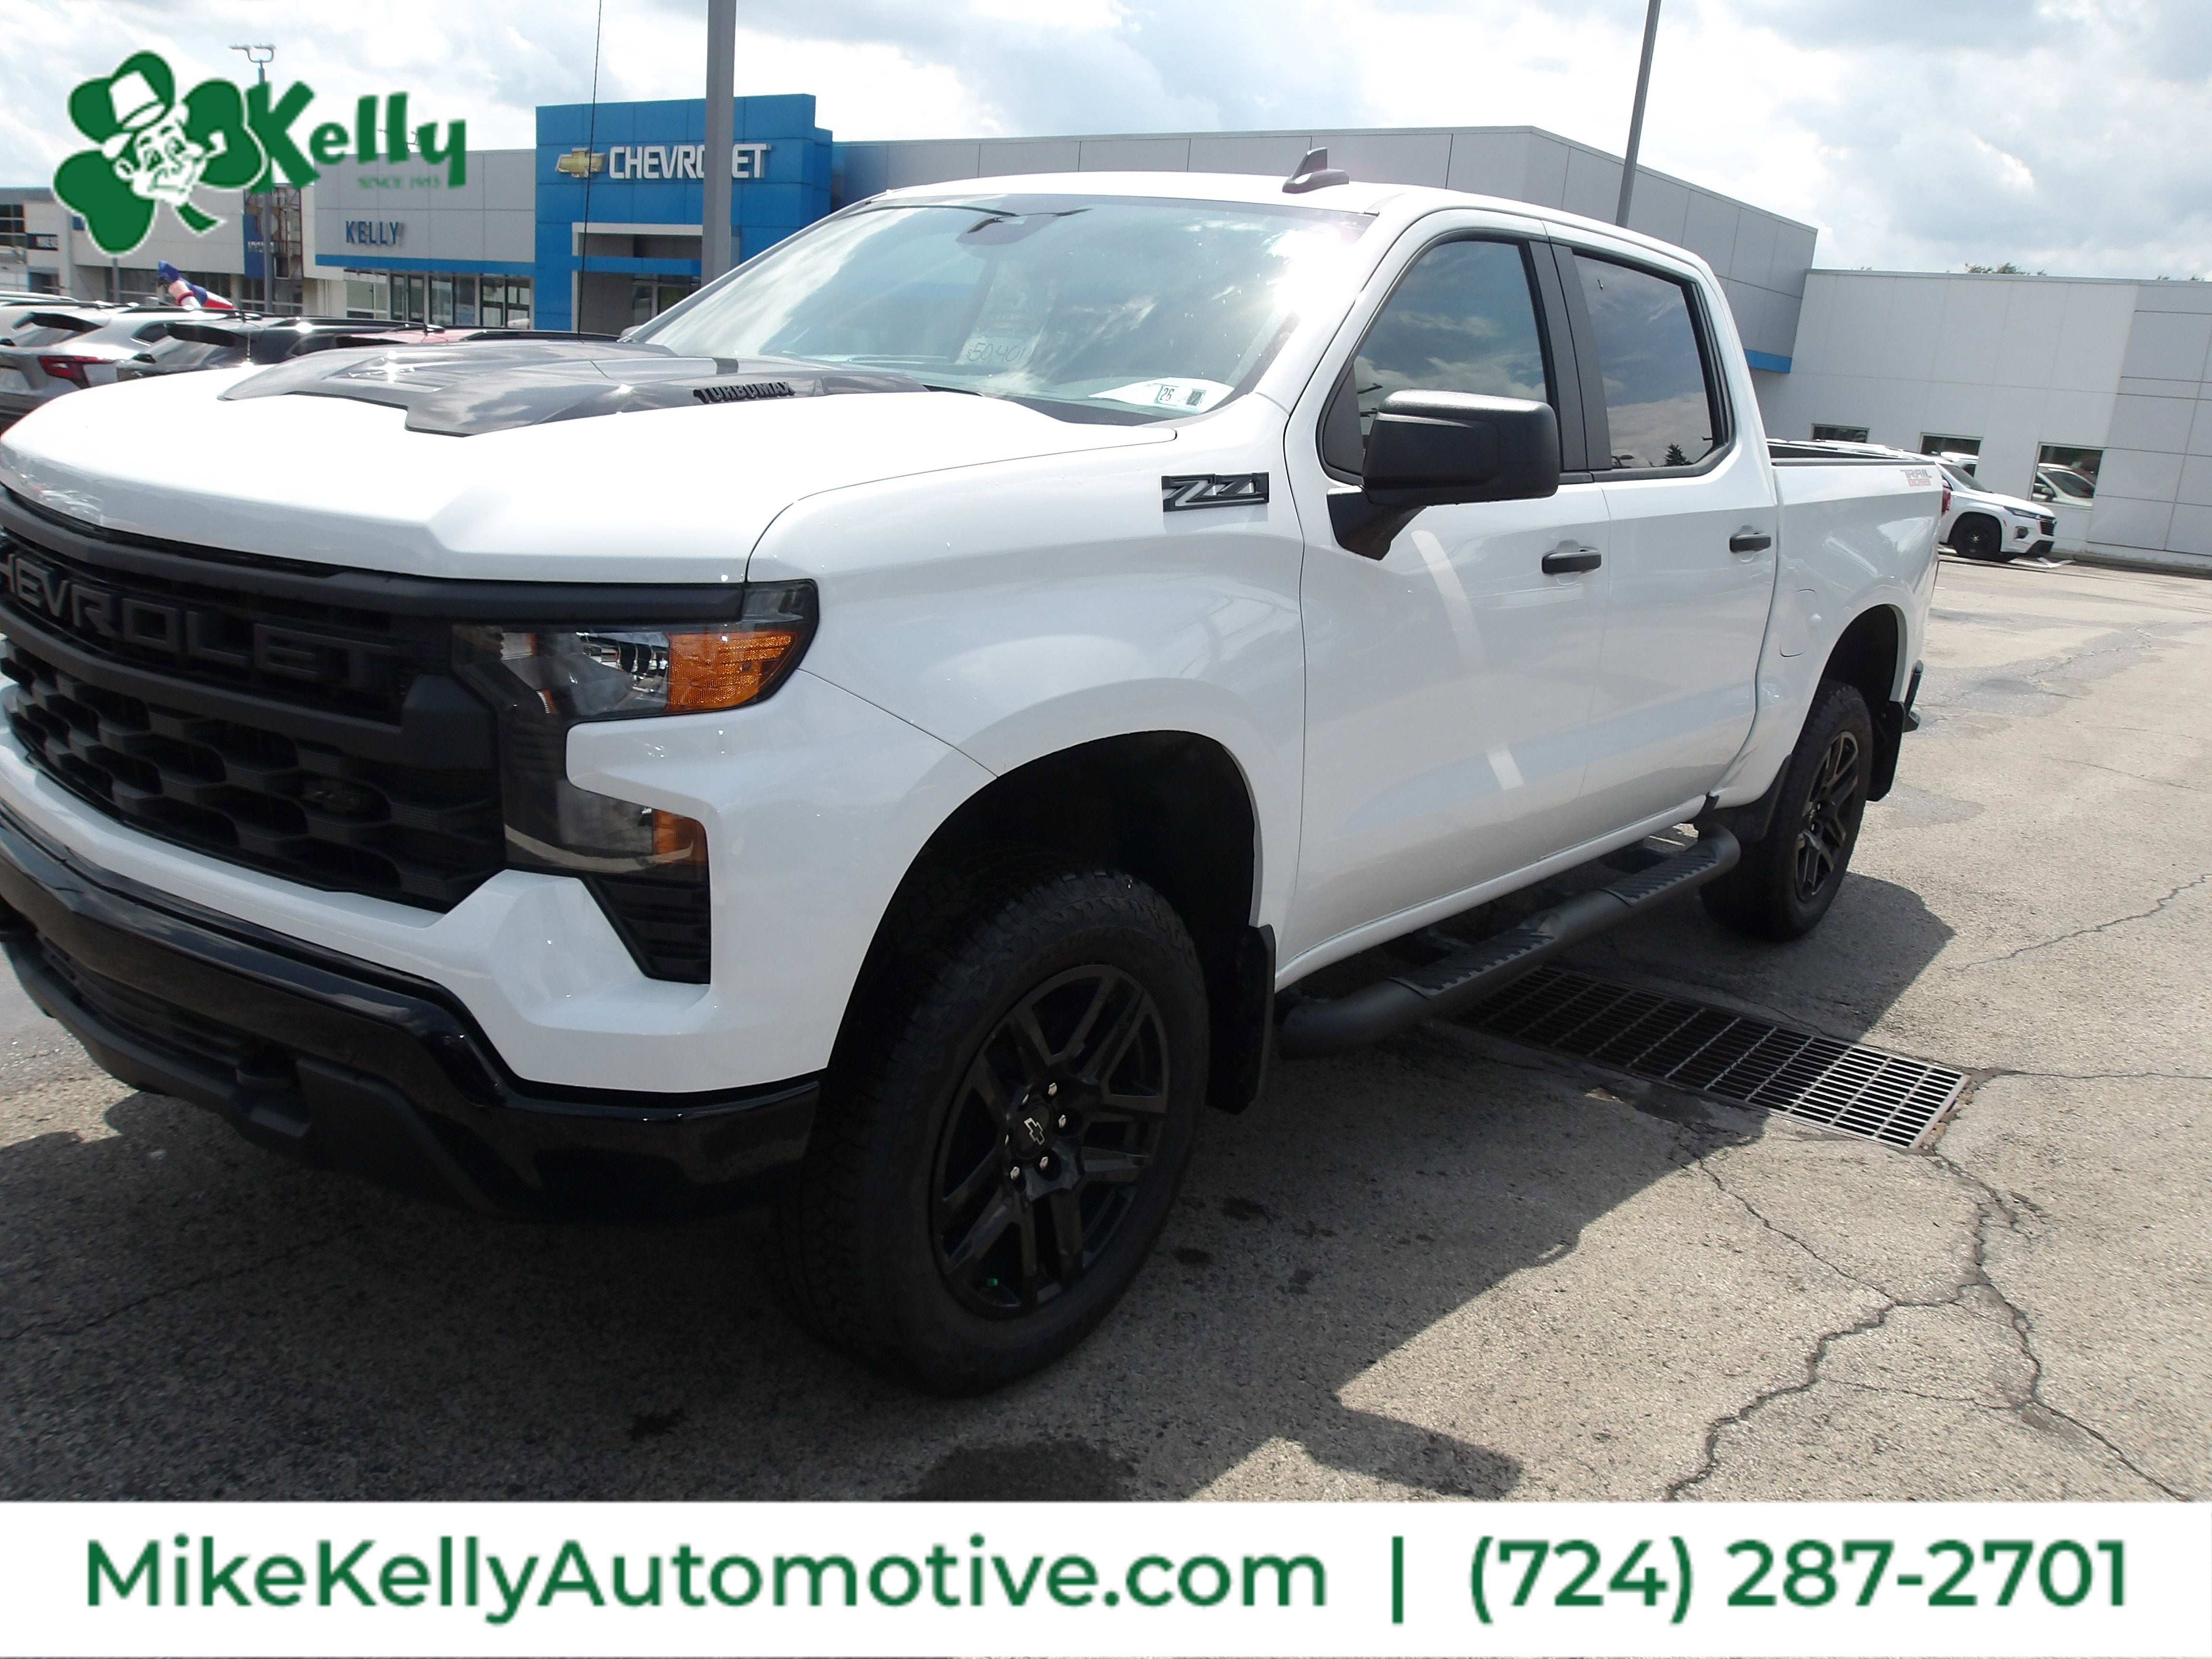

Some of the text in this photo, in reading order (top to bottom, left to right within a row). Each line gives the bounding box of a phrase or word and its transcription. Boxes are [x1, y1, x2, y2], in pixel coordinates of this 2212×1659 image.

[609, 144, 769, 179] CHEVRET
[345, 220, 399, 244] KELLY
[693, 382, 795, 404] TURBOMAX
[1899, 469, 1932, 479] TRAIL
[1161, 472, 1269, 512] Z71
[0, 553, 400, 687] HEVROLET
